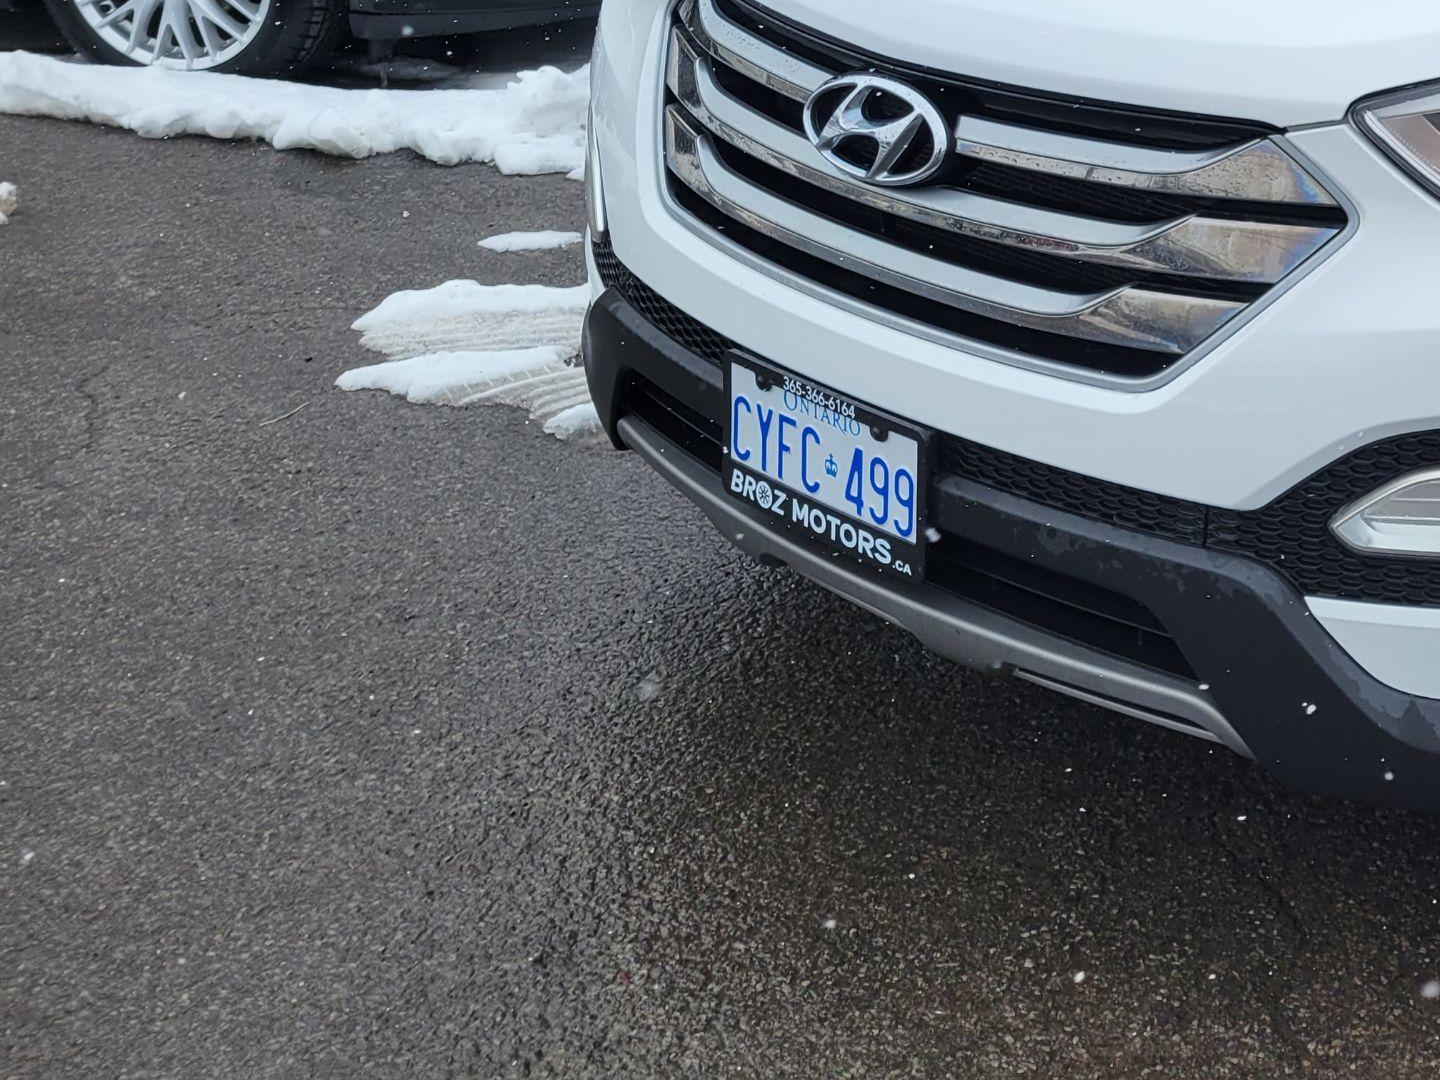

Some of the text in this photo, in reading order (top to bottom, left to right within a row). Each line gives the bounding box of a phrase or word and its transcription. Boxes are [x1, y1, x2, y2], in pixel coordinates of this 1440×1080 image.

[783, 375, 856, 420] 365-366-6164
[783, 390, 861, 437] ONTARIO
[733, 395, 915, 538] CYFC 499
[730, 468, 788, 516] BROZ
